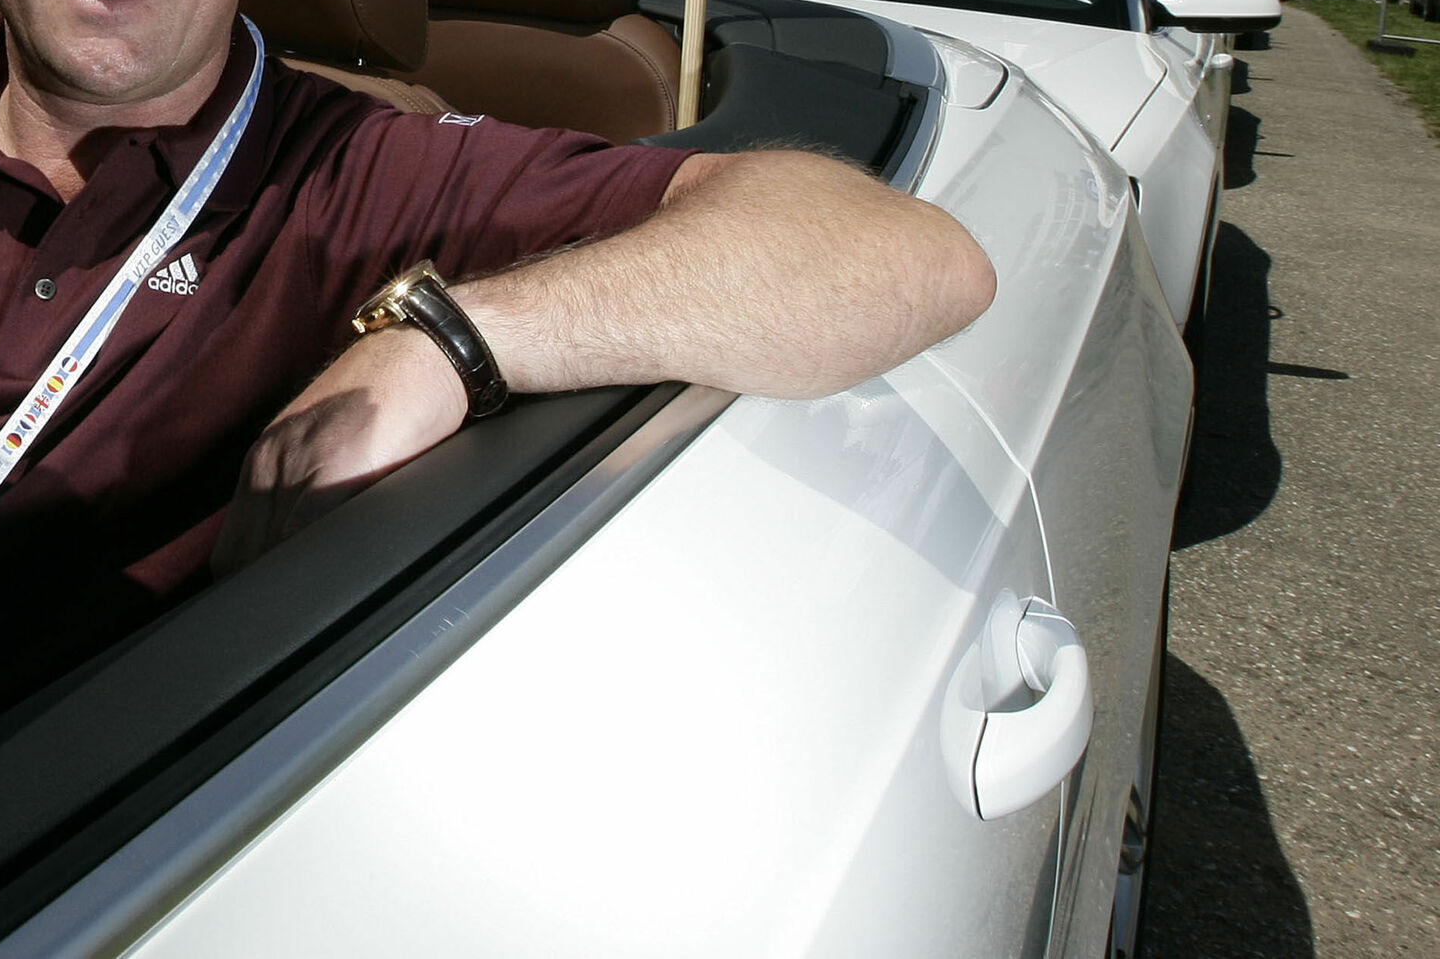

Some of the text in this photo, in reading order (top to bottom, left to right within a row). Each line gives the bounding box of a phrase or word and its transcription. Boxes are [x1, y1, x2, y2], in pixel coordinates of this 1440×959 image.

[133, 214, 181, 278] VIP GUEST
[148, 276, 199, 296] adid
